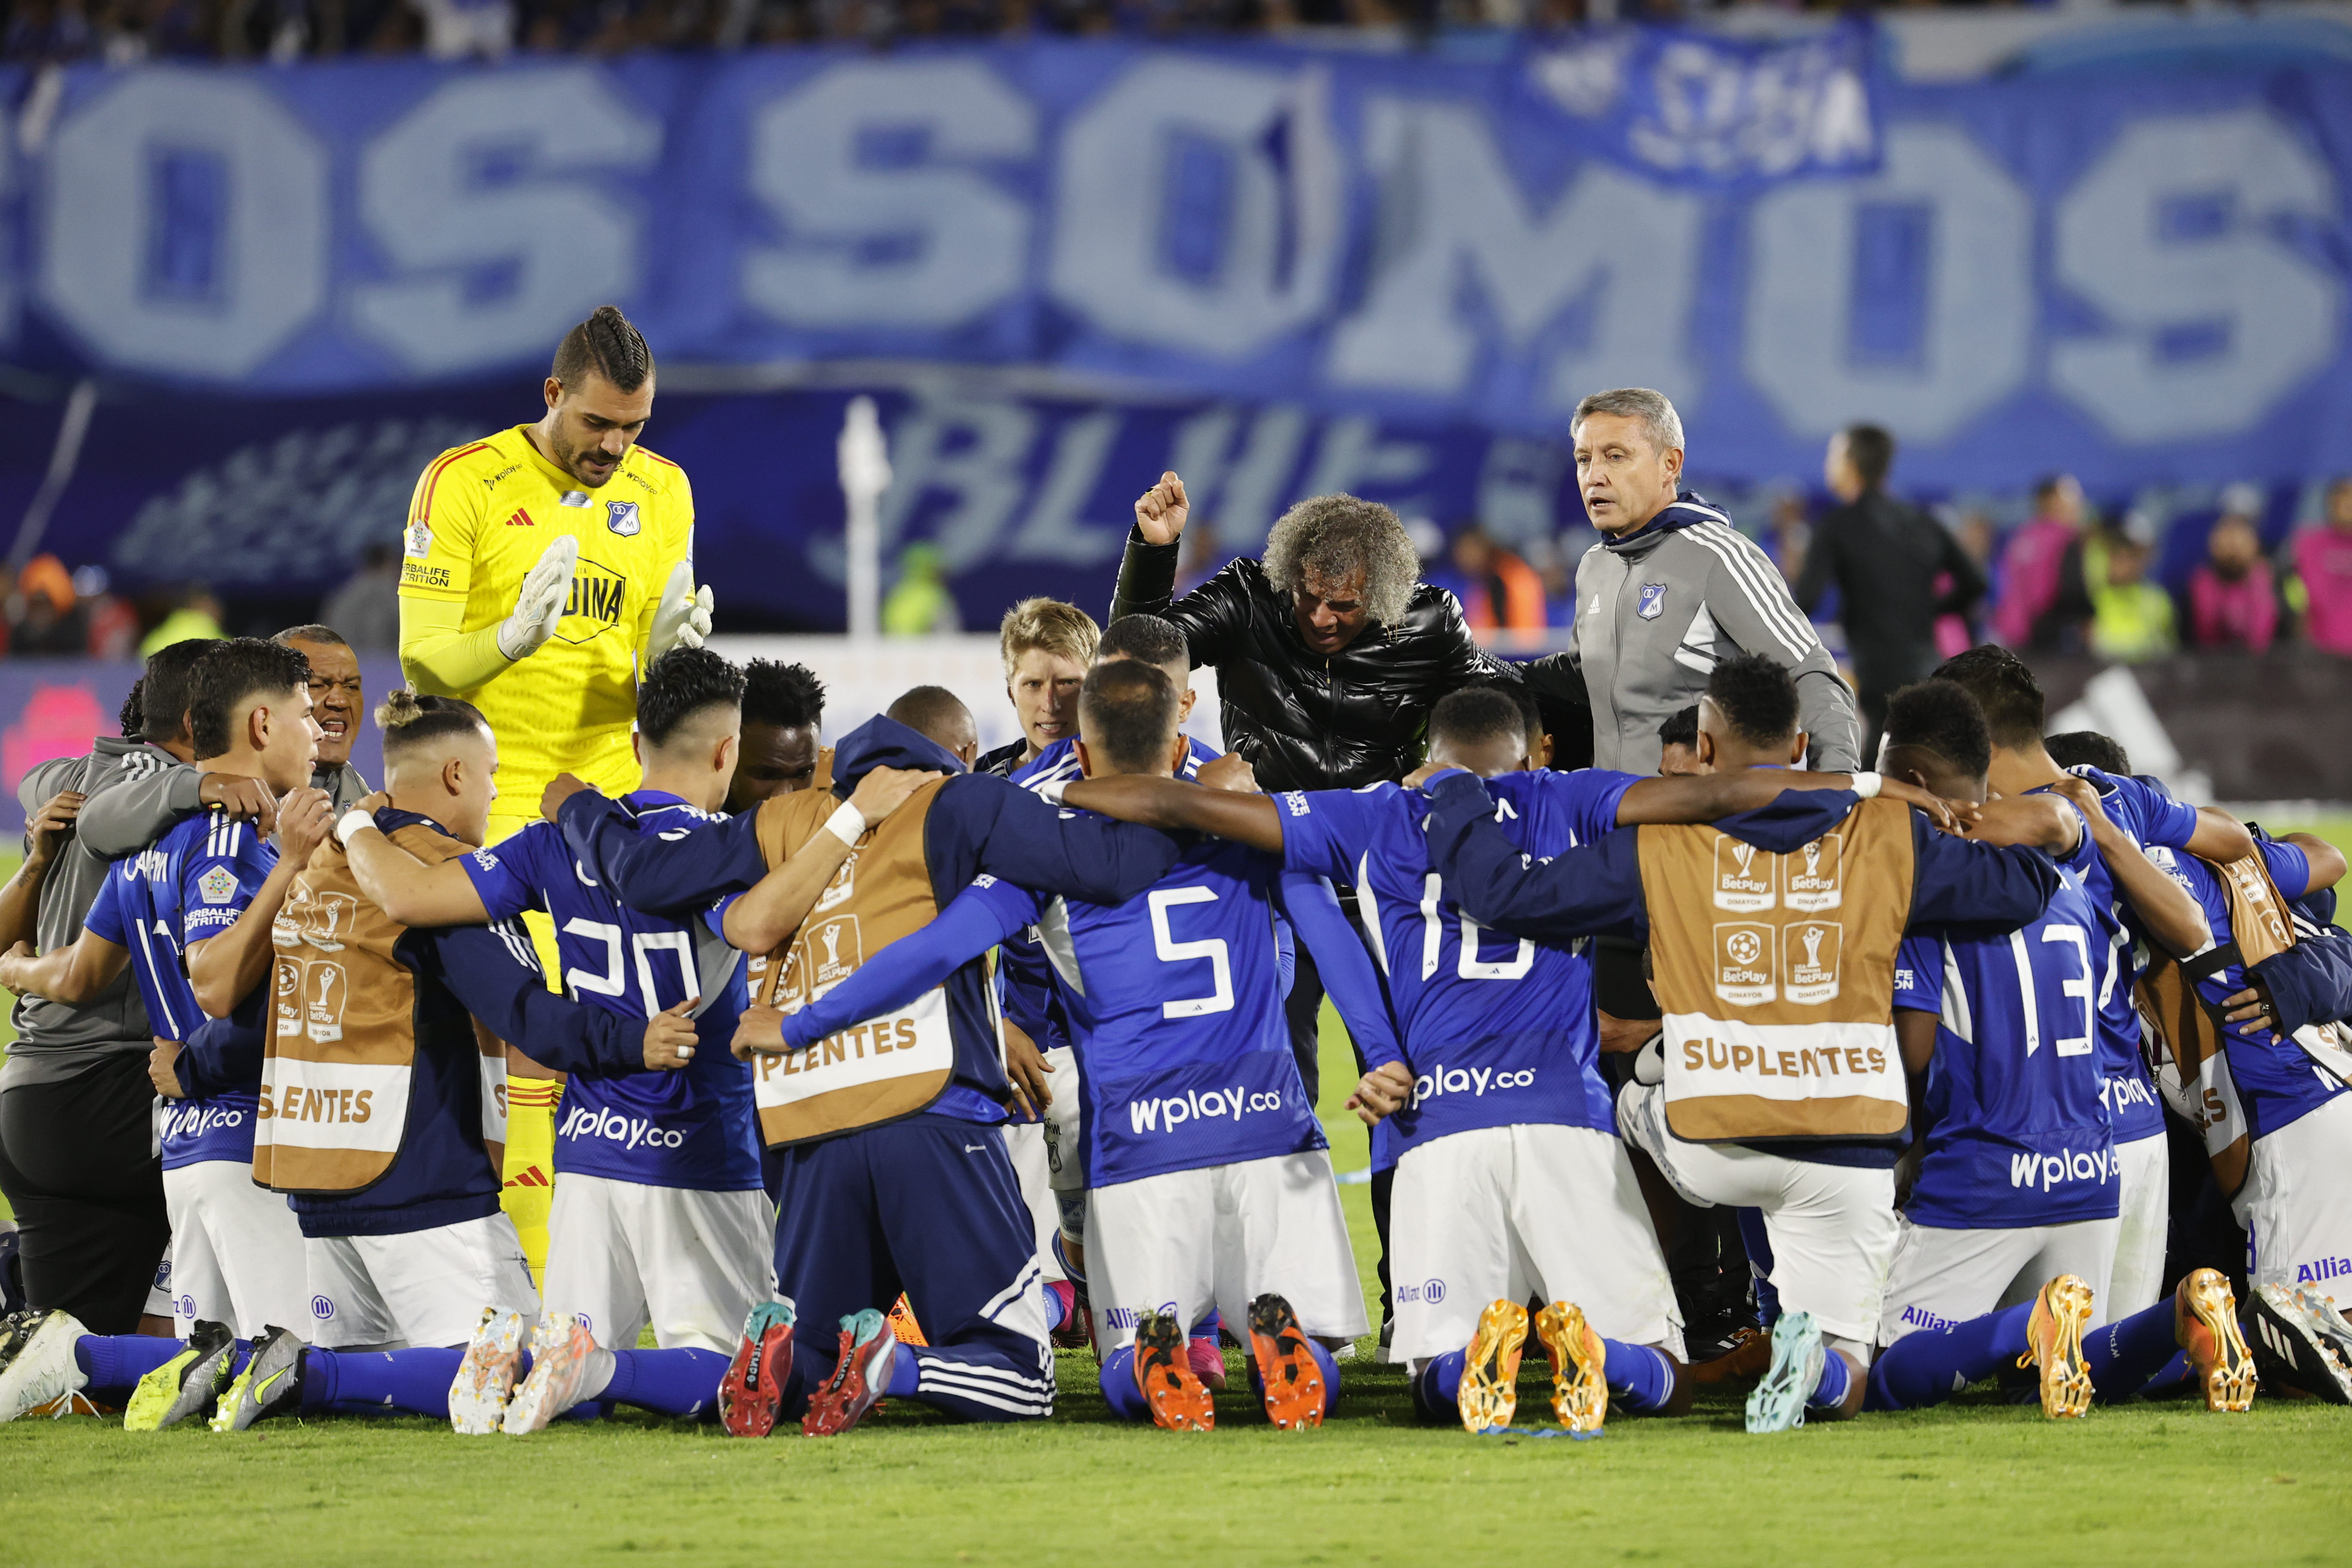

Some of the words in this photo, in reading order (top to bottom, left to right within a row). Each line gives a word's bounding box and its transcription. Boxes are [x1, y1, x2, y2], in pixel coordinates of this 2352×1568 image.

[742, 55, 2338, 445] SOMOS
[1650, 603, 1658, 612] M
[1722, 878, 1767, 893] BetPlay
[1792, 878, 1834, 891] BetPlay
[1148, 885, 1235, 1019] 5
[562, 917, 701, 1023] 20
[1723, 970, 1767, 985] BetPlay
[1795, 971, 1833, 984] BetPlay
[1798, 989, 1830, 998] DIMAYOR
[2009, 924, 2093, 1058] 13
[309, 1010, 334, 1024] BetPlay
[1684, 1037, 1886, 1078] SUPLENTES
